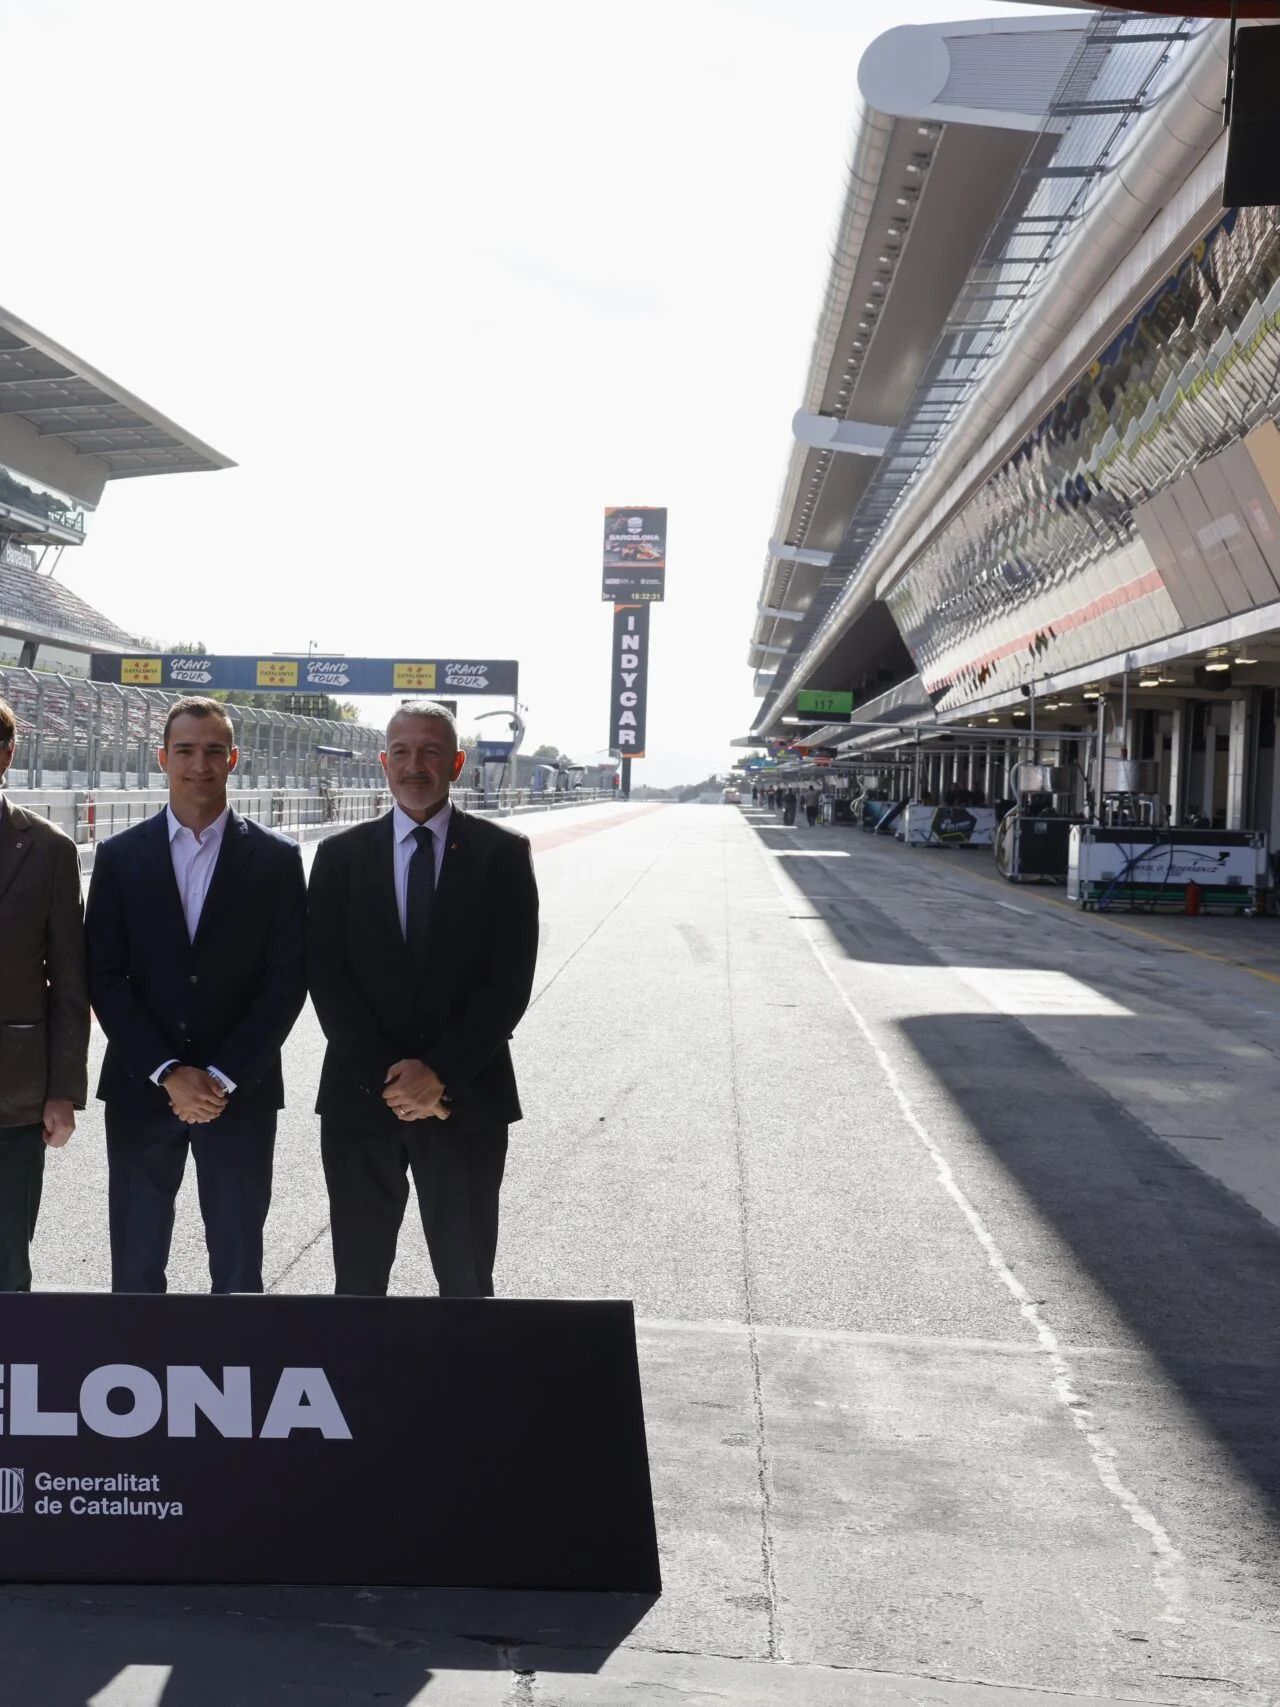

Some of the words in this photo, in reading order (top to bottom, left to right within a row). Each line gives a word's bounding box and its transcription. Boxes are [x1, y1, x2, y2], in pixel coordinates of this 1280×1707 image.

[170, 658, 212, 671] GRAND
[307, 661, 349, 673] GRAND
[445, 663, 489, 675] GRAND
[174, 671, 207, 682] TOUR
[311, 674, 343, 684] TOUR
[450, 676, 481, 688] TOUR
[618, 615, 640, 745] INDYCAR
[814, 700, 834, 711] 117
[34, 1472, 160, 1492] Generalitat
[34, 1496, 63, 1514] de
[69, 1496, 183, 1519] Catalunya
